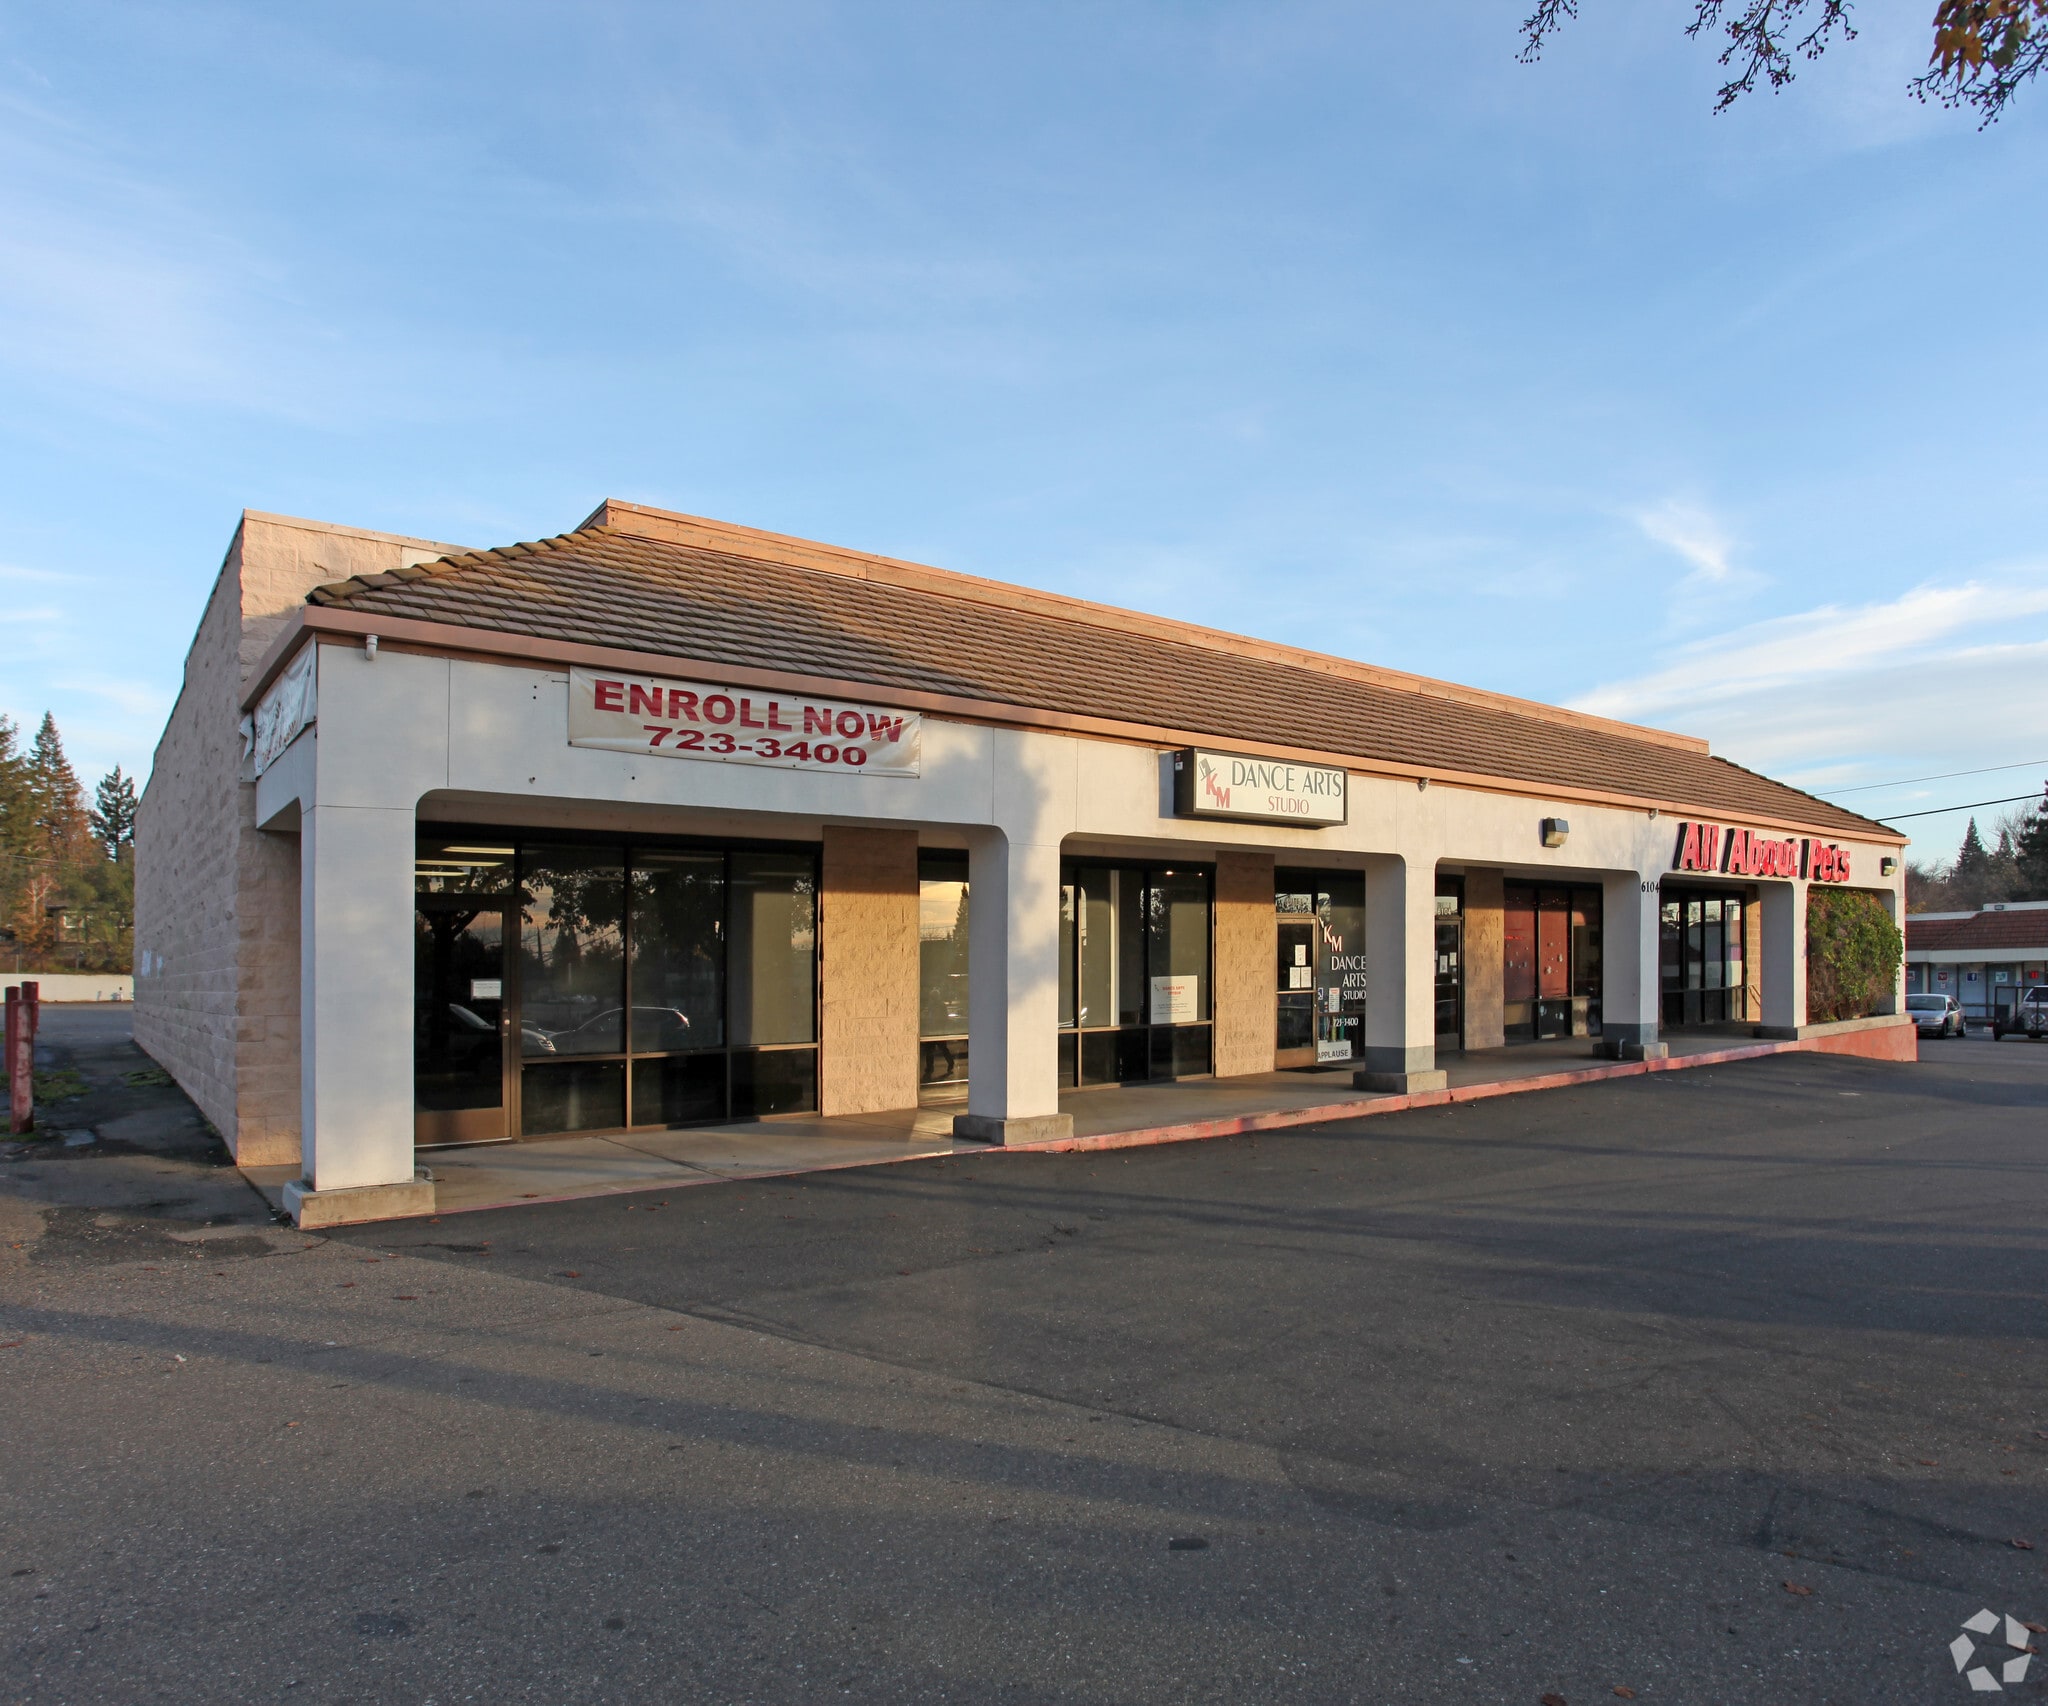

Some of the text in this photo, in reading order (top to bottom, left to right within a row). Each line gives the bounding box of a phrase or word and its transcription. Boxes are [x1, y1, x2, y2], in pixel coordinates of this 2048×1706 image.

[594, 679, 904, 743] ENROLL NOW
[643, 725, 868, 766] 723-3400
[1232, 761, 1342, 796] DANCE ARTS
[1268, 796, 1309, 814] STUDIO
[1672, 822, 1851, 882] All About Pets
[1641, 881, 1660, 893] 6104
[1323, 924, 1343, 952] KM
[1331, 955, 1366, 971] DANCE
[1342, 972, 1366, 988] ARTS
[1343, 990, 1366, 1001] STUDIO
